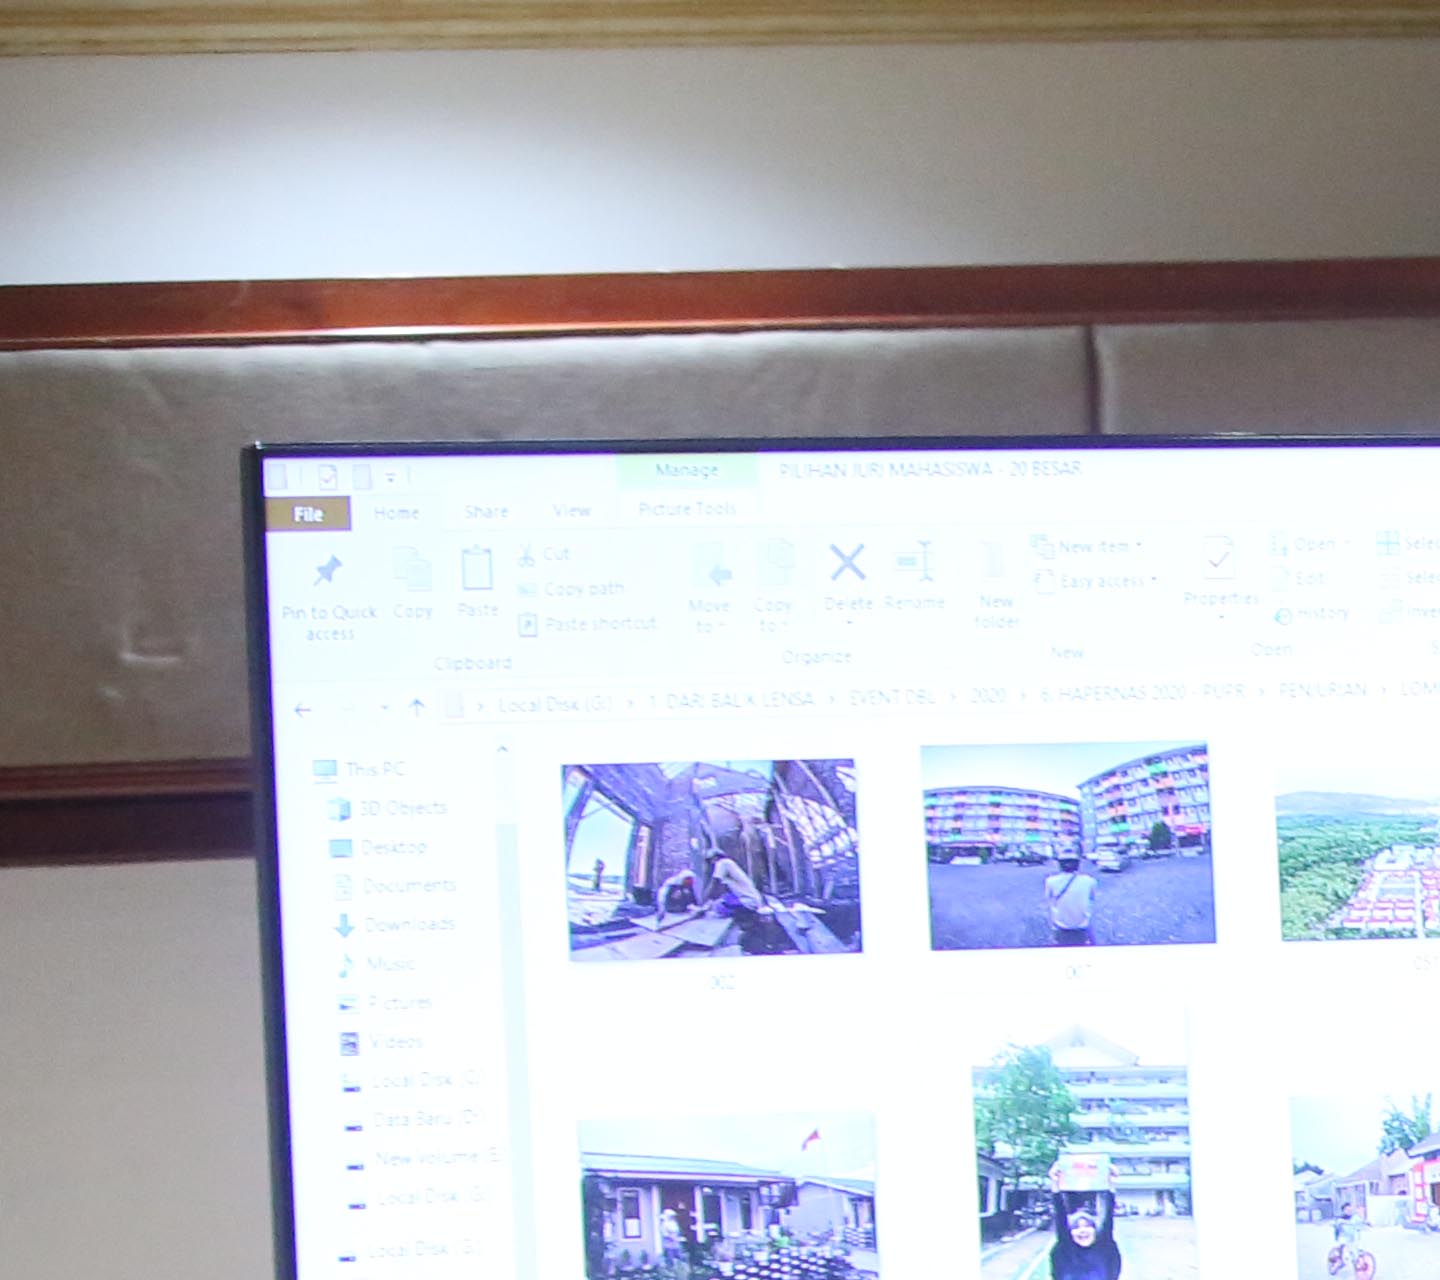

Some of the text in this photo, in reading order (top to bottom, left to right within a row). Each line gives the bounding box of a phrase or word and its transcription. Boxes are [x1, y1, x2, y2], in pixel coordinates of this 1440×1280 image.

[655, 463, 719, 480] Manage
[293, 505, 324, 523] File
[373, 504, 421, 521] Home
[463, 503, 510, 519] Share
[551, 503, 593, 518] View
